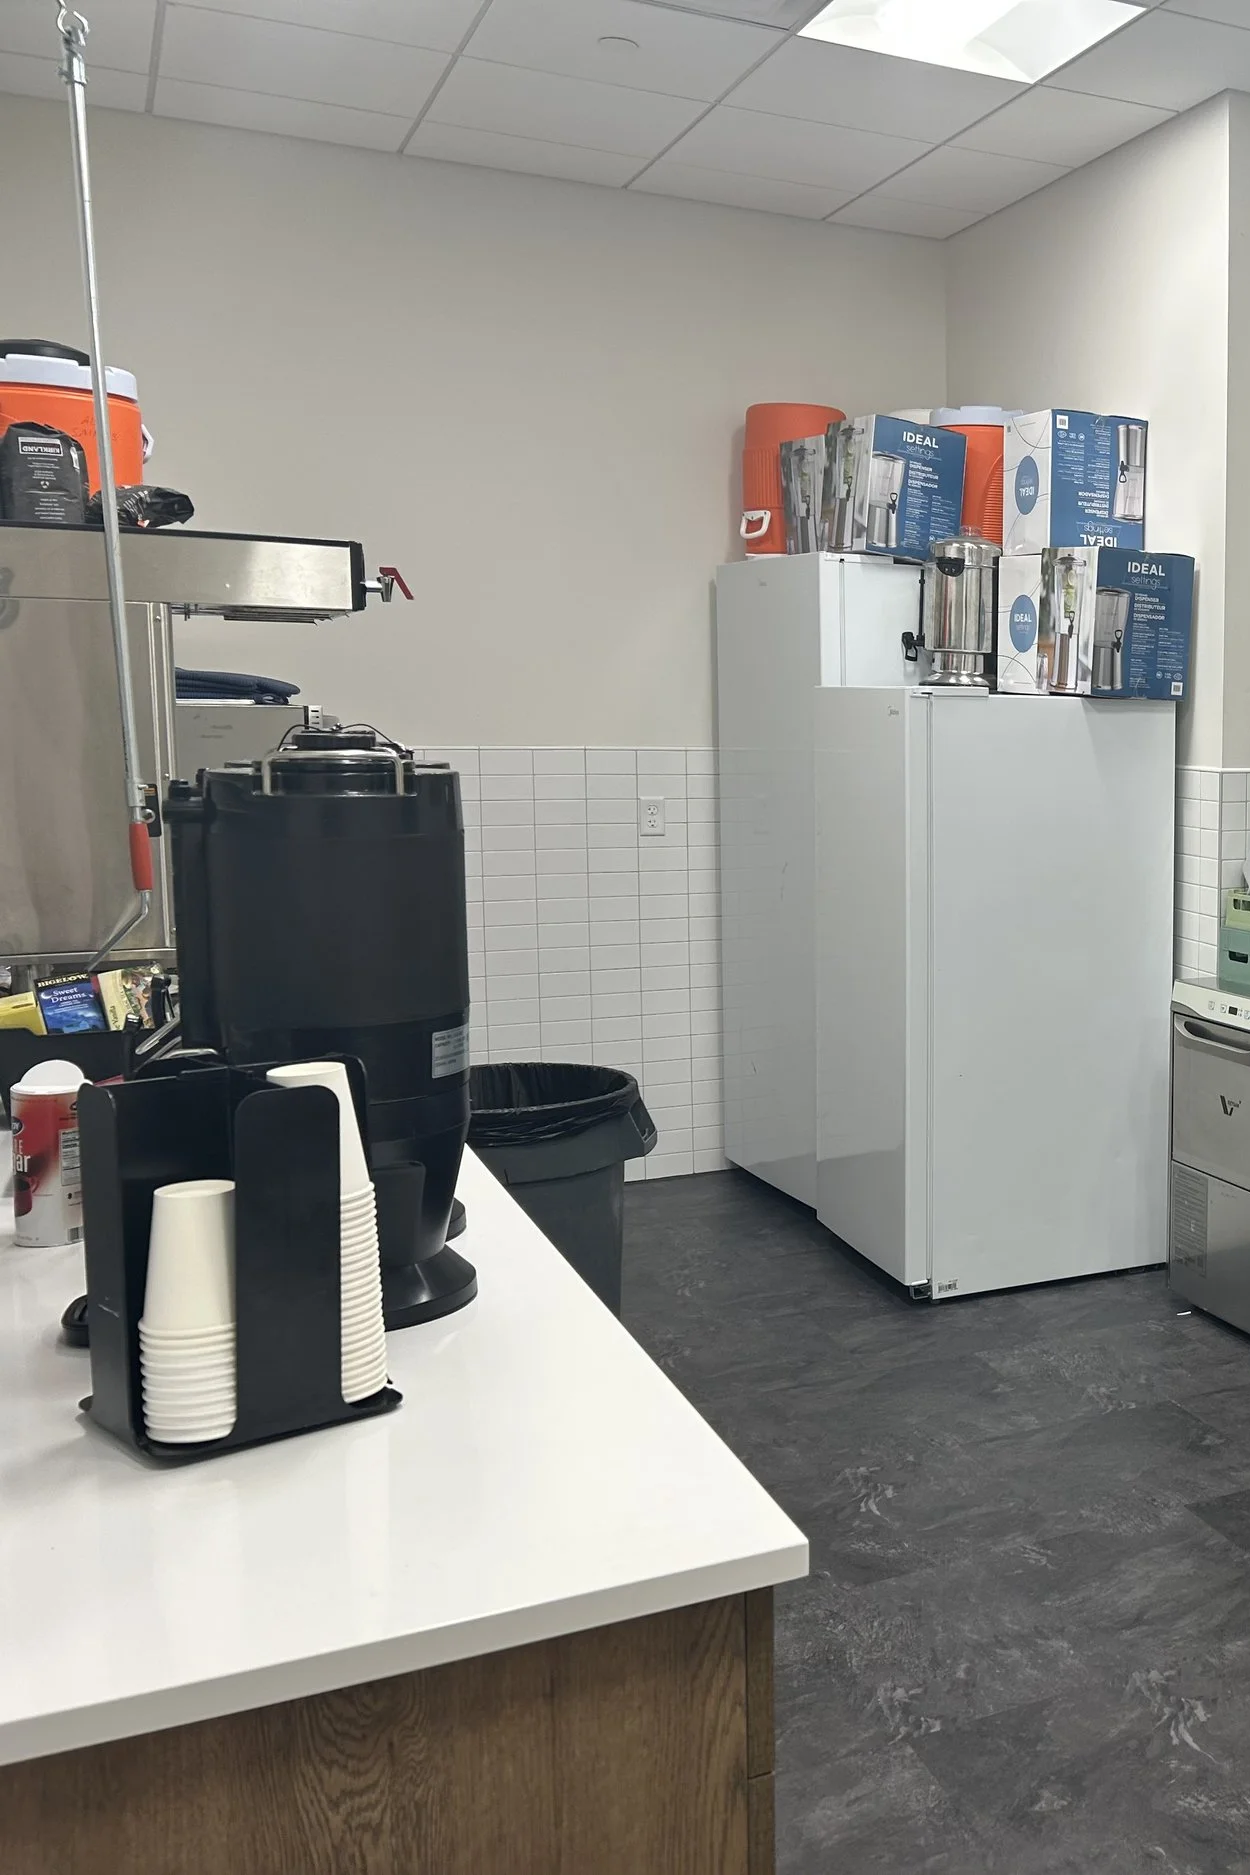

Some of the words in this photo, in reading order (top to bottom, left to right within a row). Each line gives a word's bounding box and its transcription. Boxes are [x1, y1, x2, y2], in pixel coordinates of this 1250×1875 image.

[903, 431, 939, 449] IDEAL
[22, 445, 60, 454] KIRKLAND
[906, 445, 935, 461] settings
[1019, 486, 1035, 497] IDEAL
[1083, 520, 1114, 534] settings
[1080, 534, 1118, 548] IDEAL
[1128, 562, 1165, 576] IDEAL
[1131, 576, 1160, 590] settings
[1013, 613, 1033, 623] IDEAL
[37, 973, 89, 988] BIGELOW
[51, 992, 87, 1004] Dreams
[52, 987, 78, 997] Sweet
